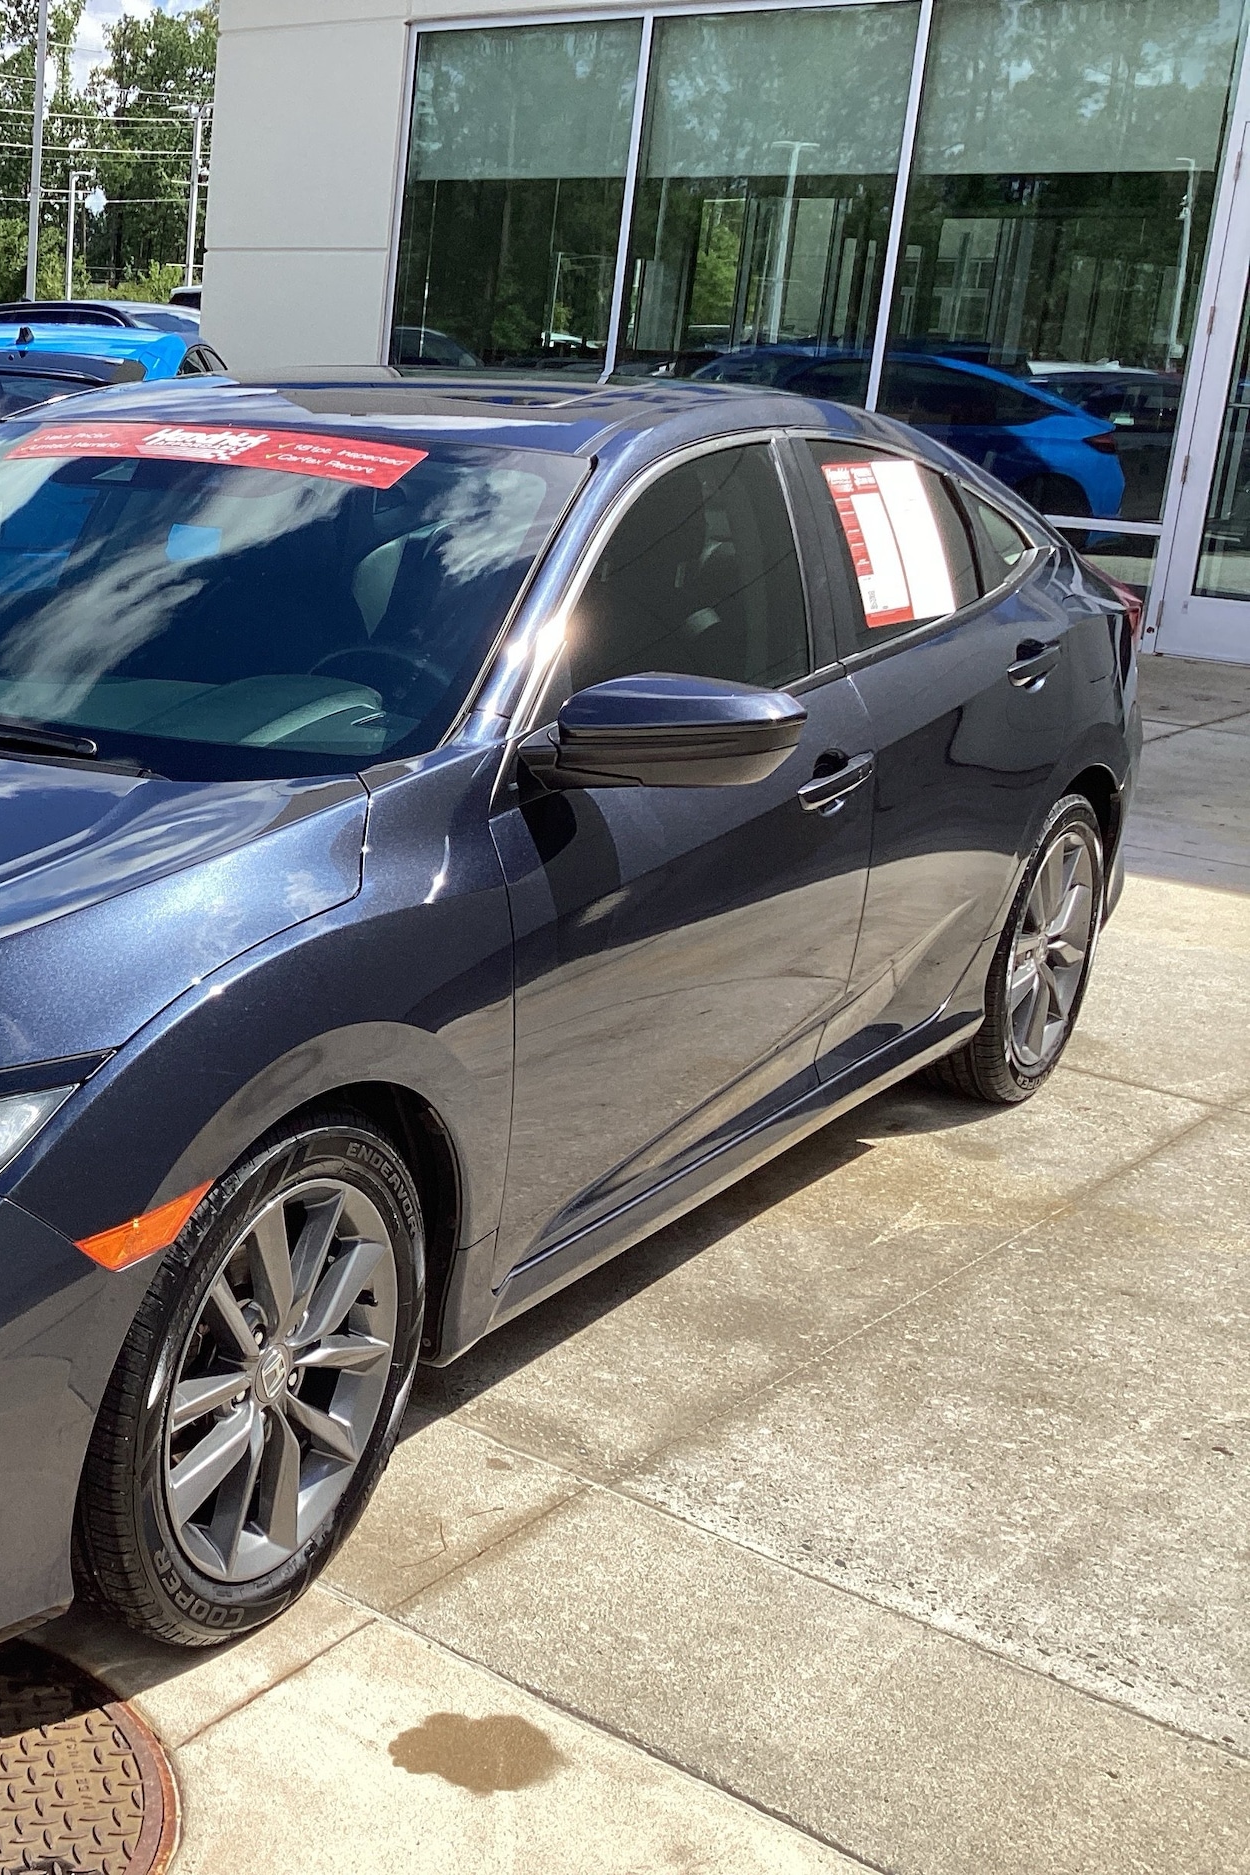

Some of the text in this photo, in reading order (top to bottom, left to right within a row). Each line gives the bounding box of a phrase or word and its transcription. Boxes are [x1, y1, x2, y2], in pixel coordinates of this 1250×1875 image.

[325, 459, 377, 475] Report
[337, 449, 411, 466] Inspected
[346, 1142, 417, 1237] ENDEAVOR
[153, 1548, 245, 1628] COOPER
